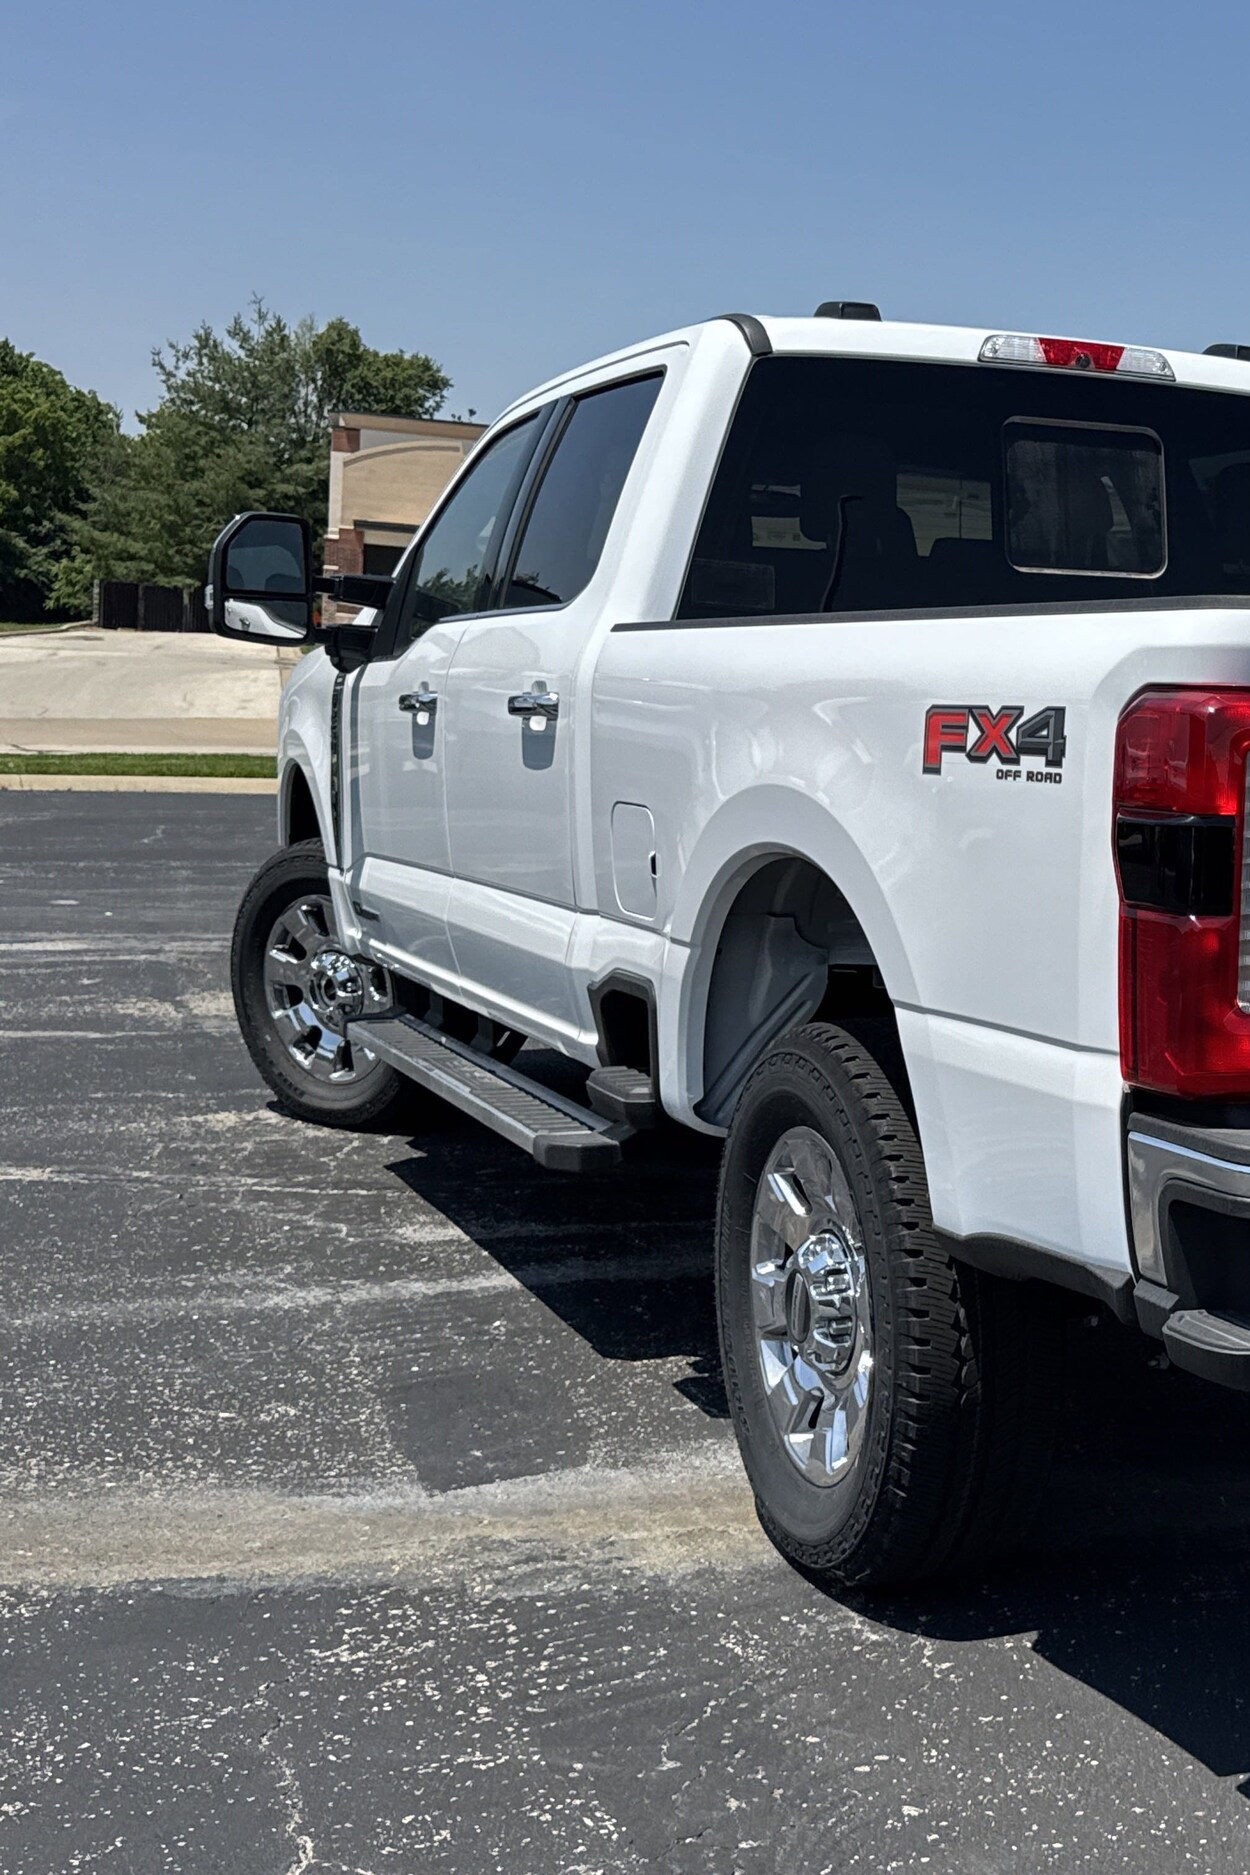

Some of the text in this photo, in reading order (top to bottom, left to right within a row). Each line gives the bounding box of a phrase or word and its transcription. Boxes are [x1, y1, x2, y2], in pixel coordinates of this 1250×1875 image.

[923, 704, 1066, 775] FX4
[996, 769, 1062, 784] OFF ROAD
